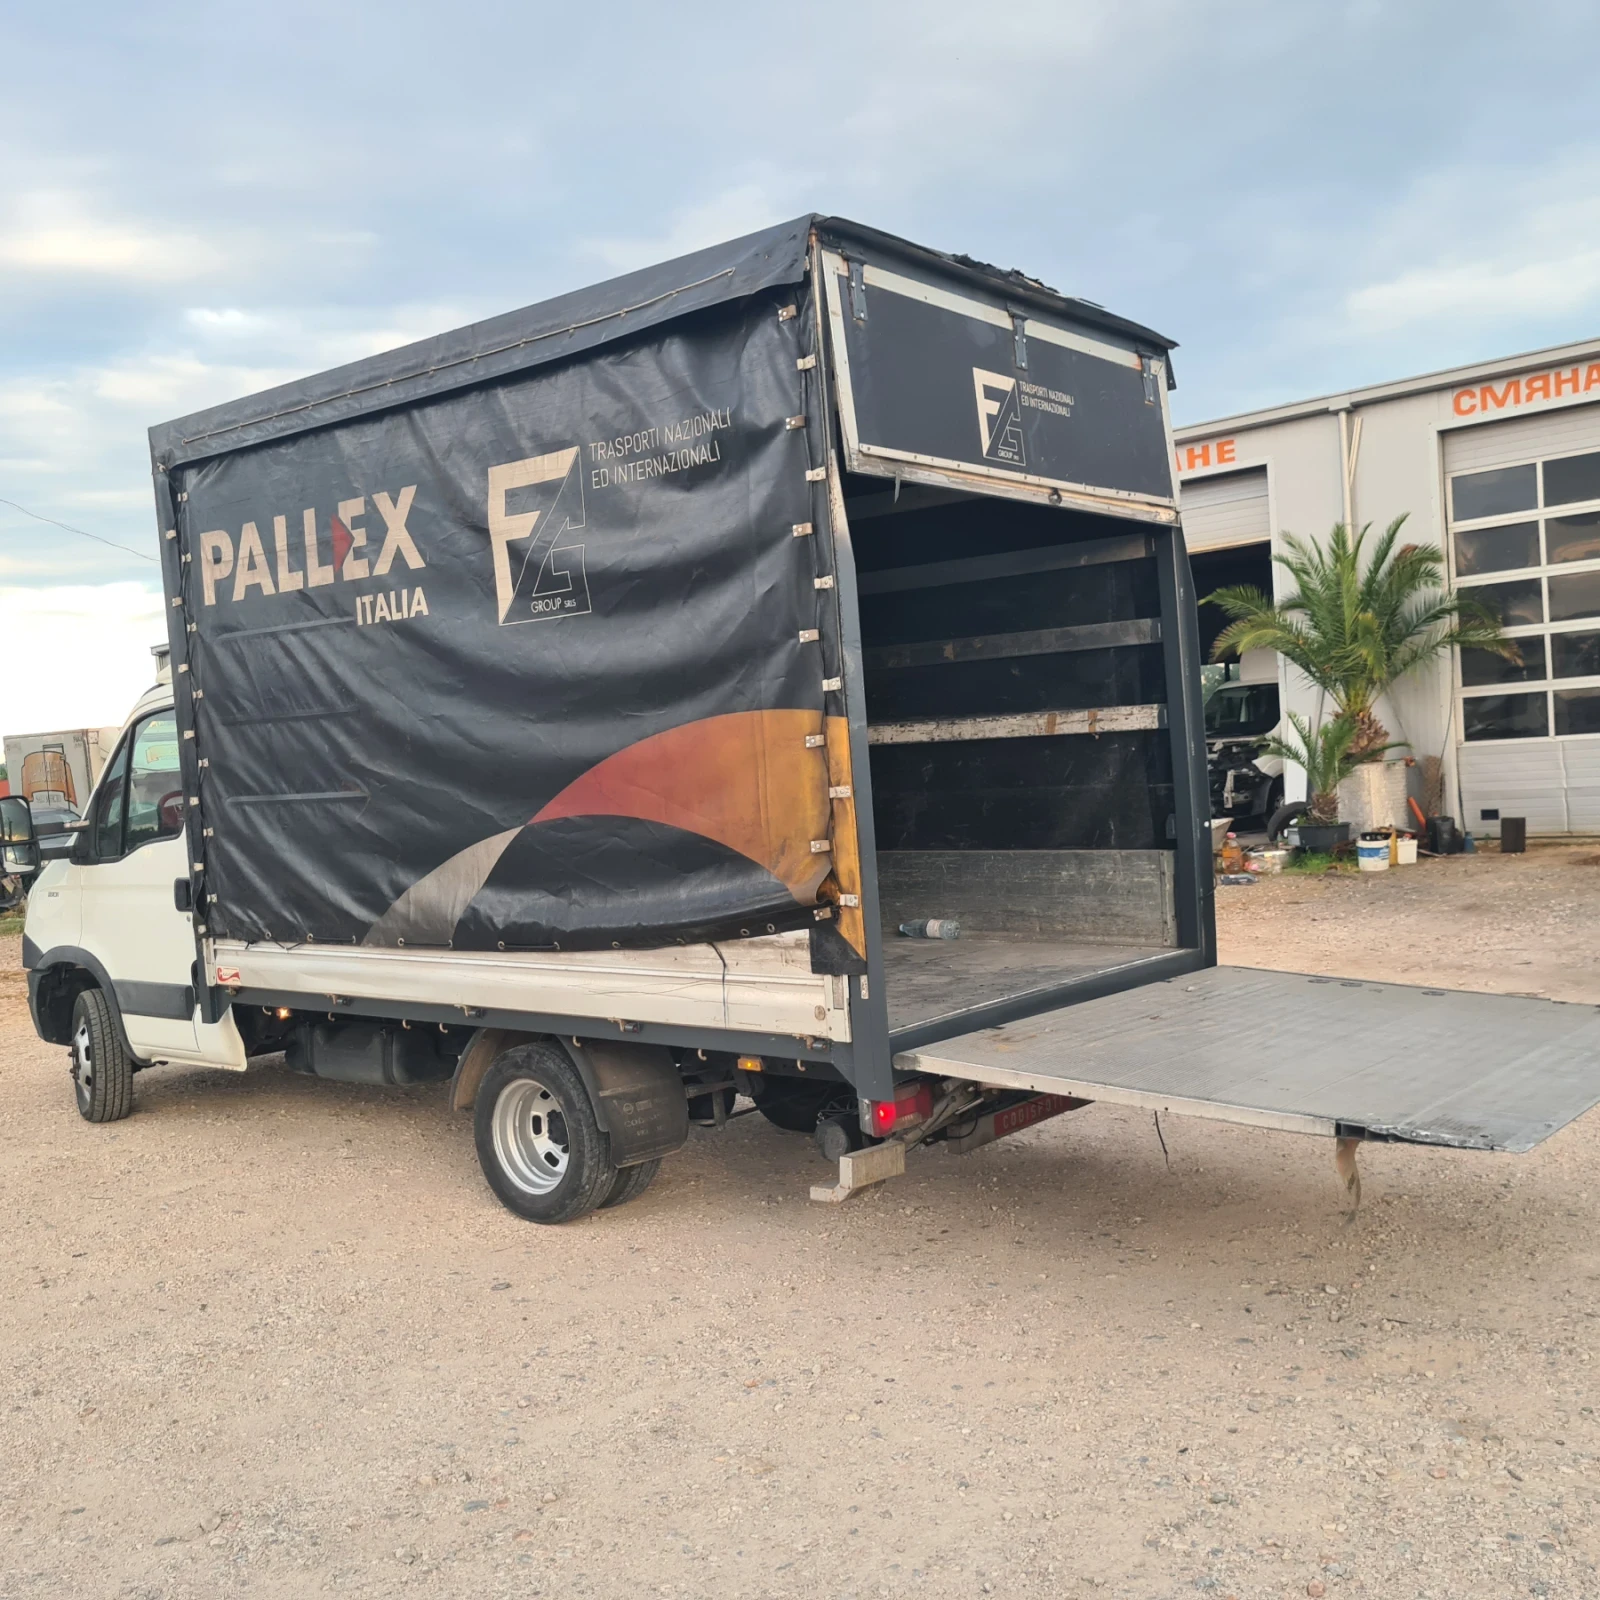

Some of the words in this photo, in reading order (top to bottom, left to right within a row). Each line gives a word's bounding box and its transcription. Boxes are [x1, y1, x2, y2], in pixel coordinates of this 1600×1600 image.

[1019, 380, 1048, 398] TRASPORTI
[1048, 388, 1075, 406] NAZIONALI
[1021, 394, 1030, 406] ED
[1029, 397, 1071, 417] INTERNAZIONALI
[1453, 362, 1600, 417] СМЯНА
[588, 428, 660, 462] TRASPORTI
[664, 406, 732, 443] NAZIONALI
[592, 469, 610, 489] ED
[614, 440, 721, 485] INTERNAZIONALI
[997, 449, 1013, 460] GROUP
[1175, 439, 1236, 472] НЕ
[200, 484, 427, 606] PALLEX
[355, 586, 429, 626] ITALIA
[530, 597, 562, 613] GROUP
